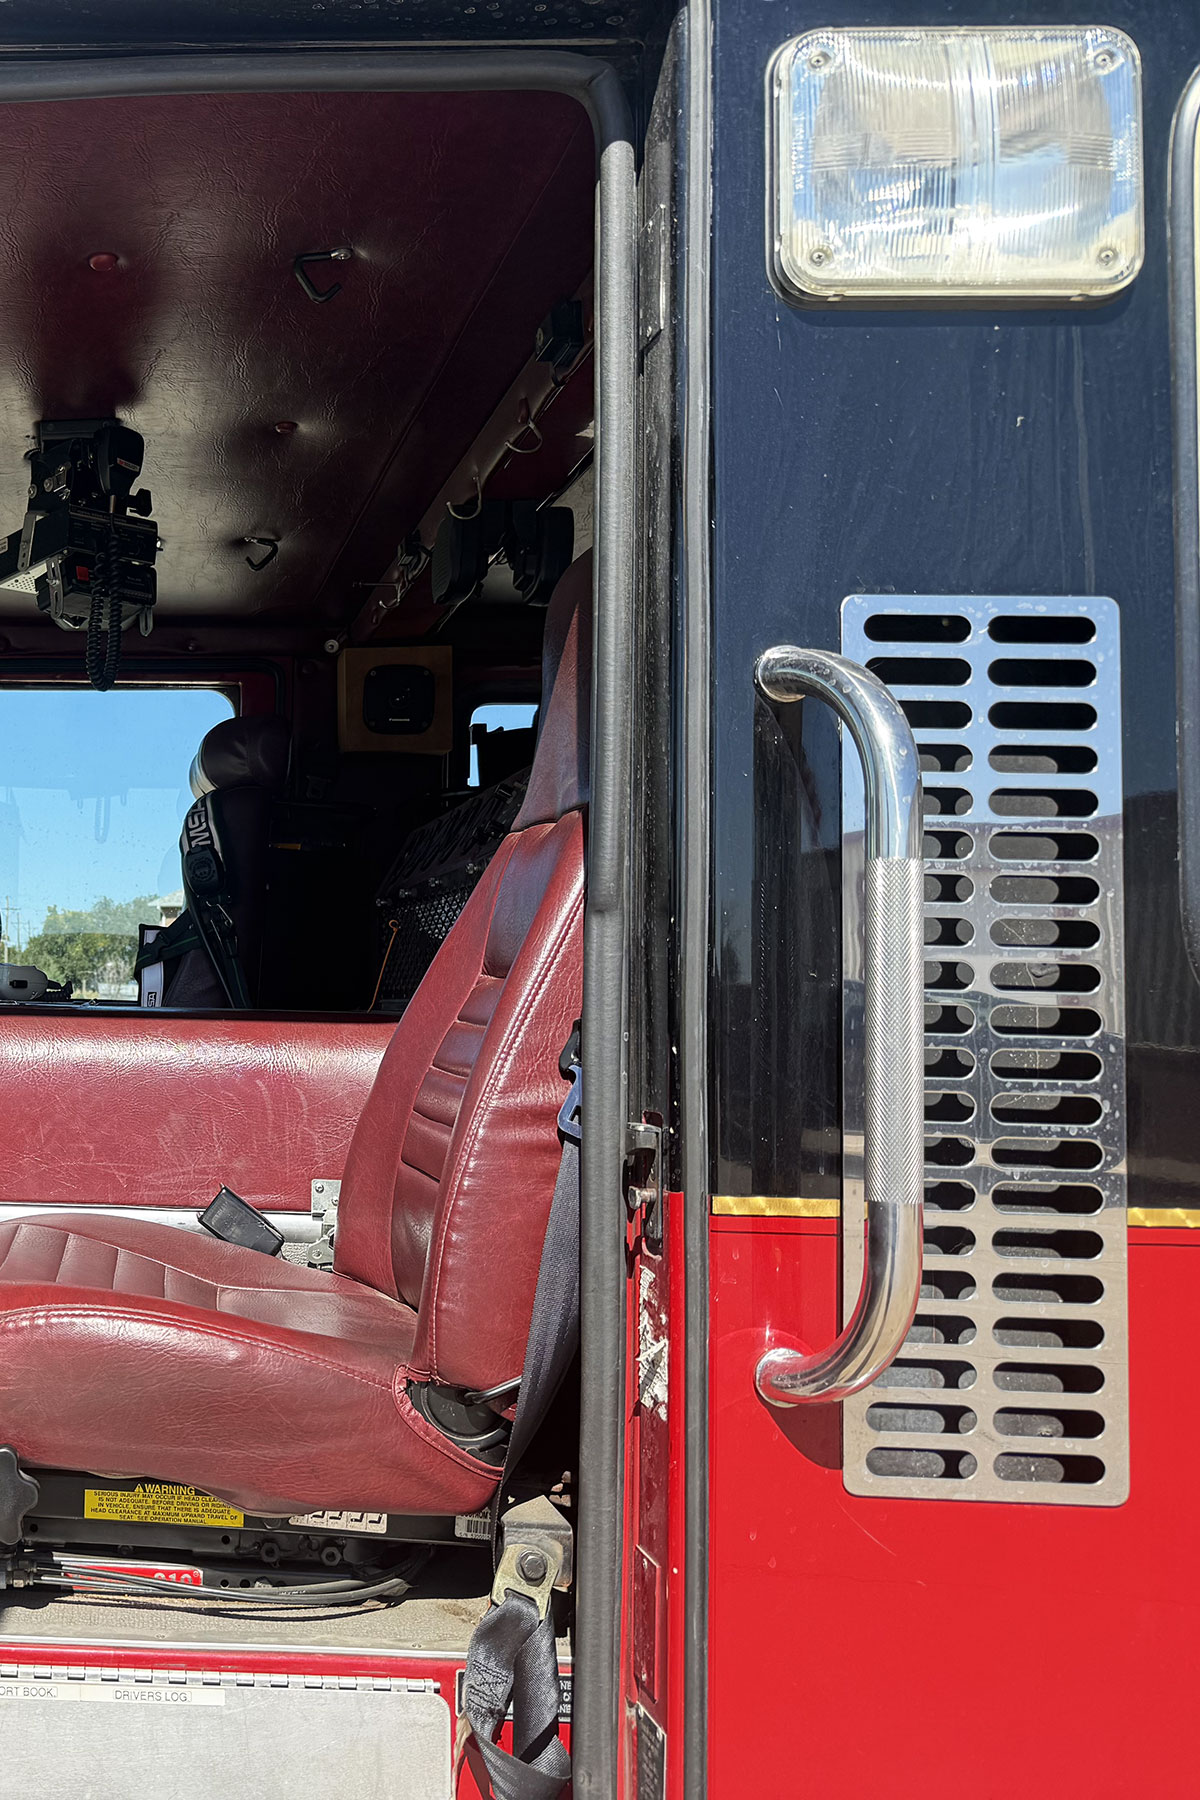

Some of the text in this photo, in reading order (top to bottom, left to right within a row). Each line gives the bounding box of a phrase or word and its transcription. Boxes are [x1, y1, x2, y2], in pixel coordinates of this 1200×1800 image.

[93, 1490, 119, 1498] SERIOUS
[144, 1483, 196, 1496] WARNING
[114, 1689, 162, 1701] DRIVERS
